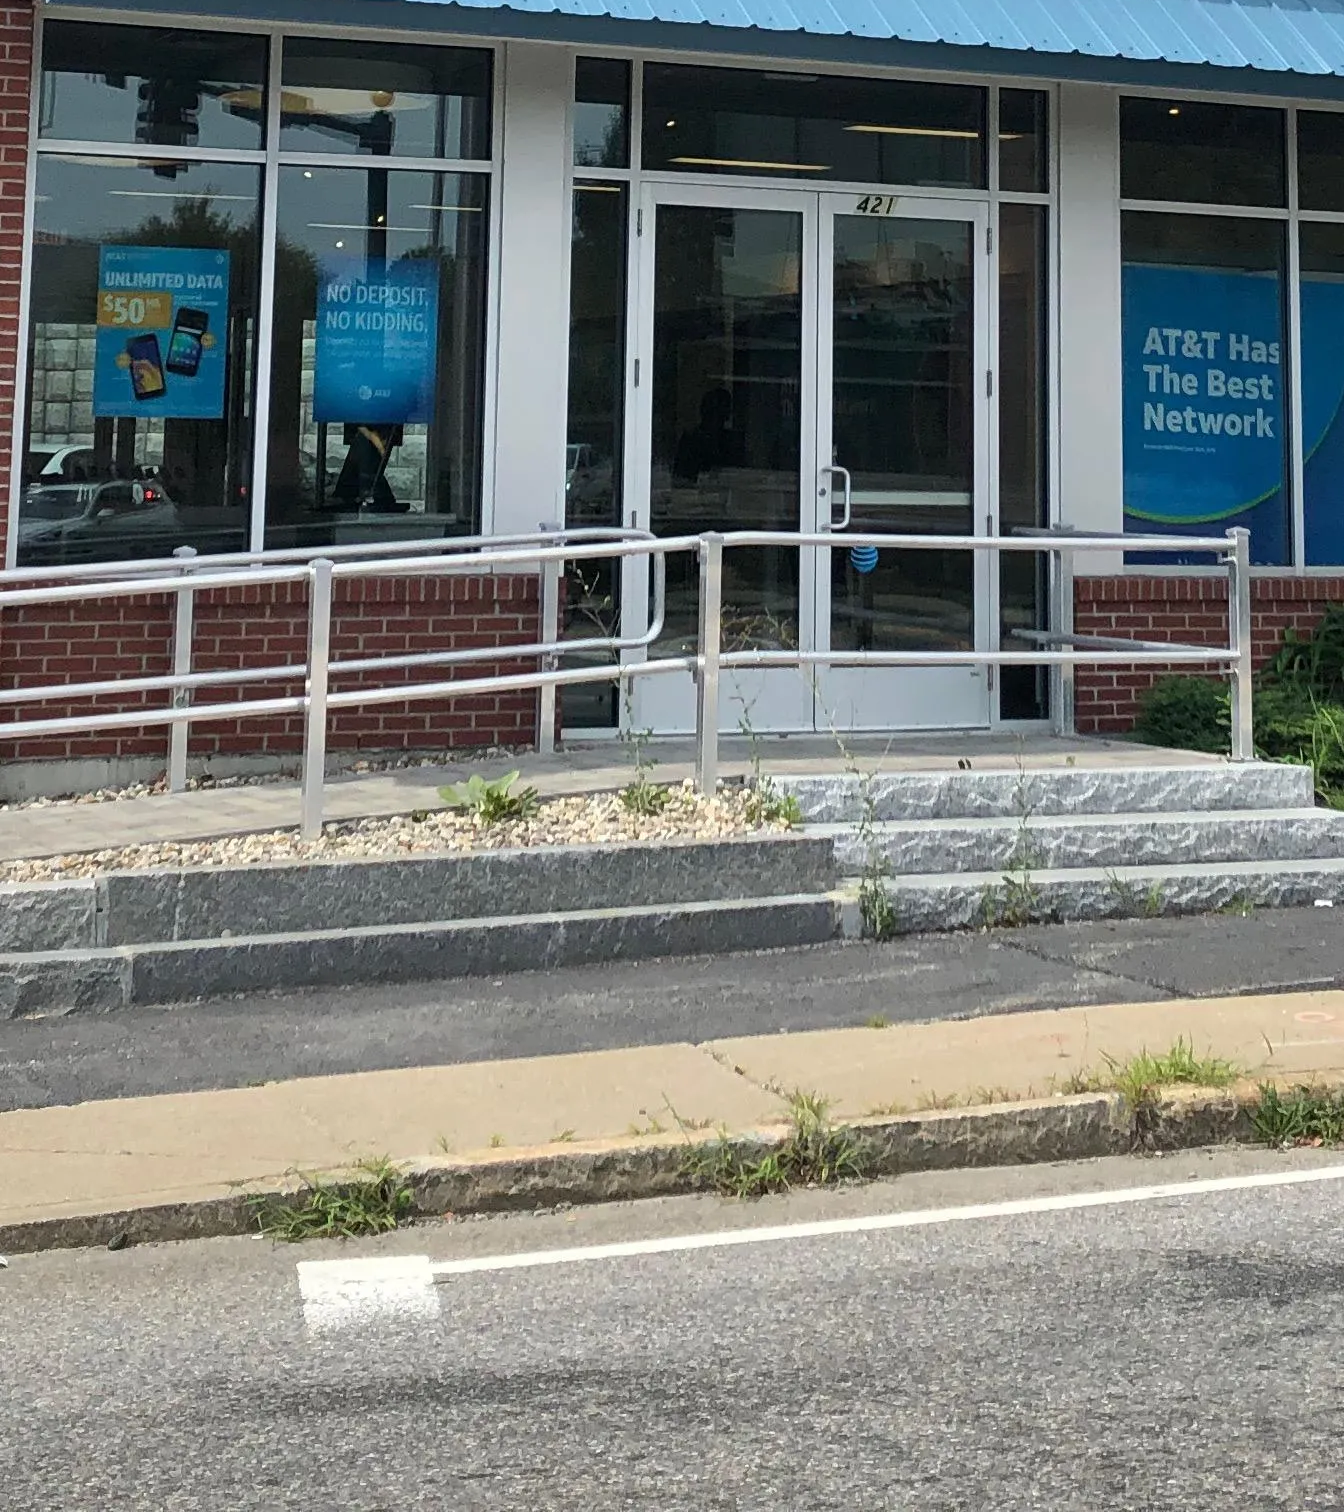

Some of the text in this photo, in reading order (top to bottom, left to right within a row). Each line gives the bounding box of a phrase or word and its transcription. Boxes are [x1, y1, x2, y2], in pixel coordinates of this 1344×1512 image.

[856, 196, 894, 214] 421
[104, 271, 224, 289] UNLIMITED DATA
[326, 284, 351, 303] NO
[325, 311, 351, 330] NO
[1142, 327, 1280, 365] AT&T Has
[1142, 364, 1274, 401] The Best
[1143, 401, 1276, 438] Network
